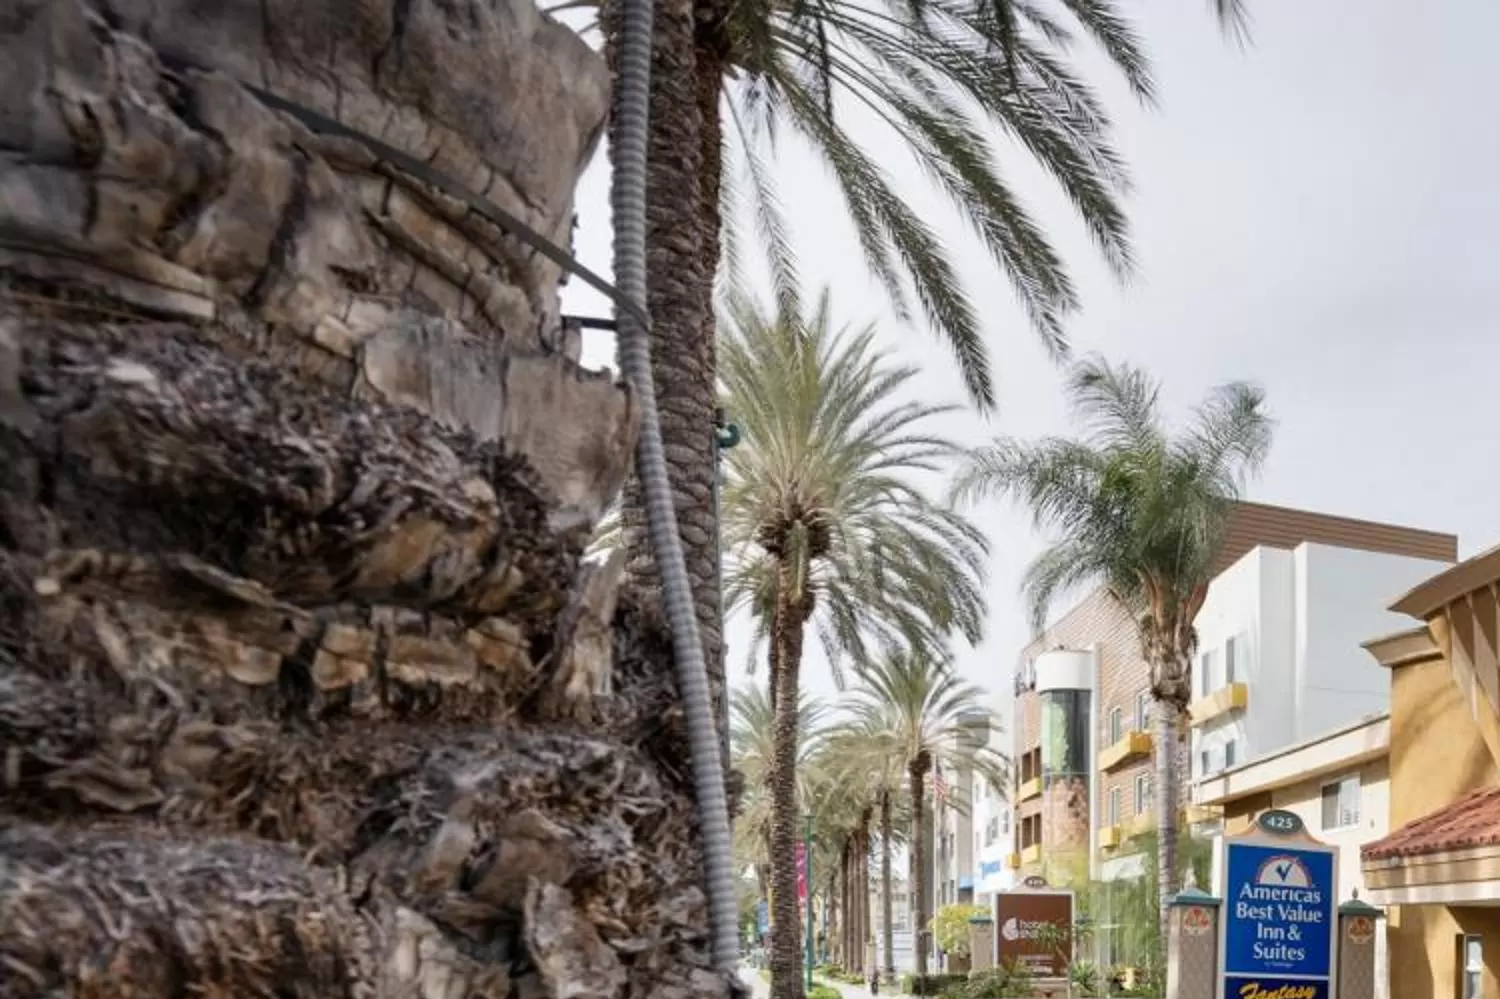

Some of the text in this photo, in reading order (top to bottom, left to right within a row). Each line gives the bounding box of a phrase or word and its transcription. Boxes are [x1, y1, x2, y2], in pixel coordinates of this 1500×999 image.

[1265, 815, 1294, 830] 425
[1240, 882, 1321, 904] Americas
[1235, 901, 1323, 923] Best Value
[1257, 921, 1302, 941] Inn &
[1252, 941, 1306, 961] Suites
